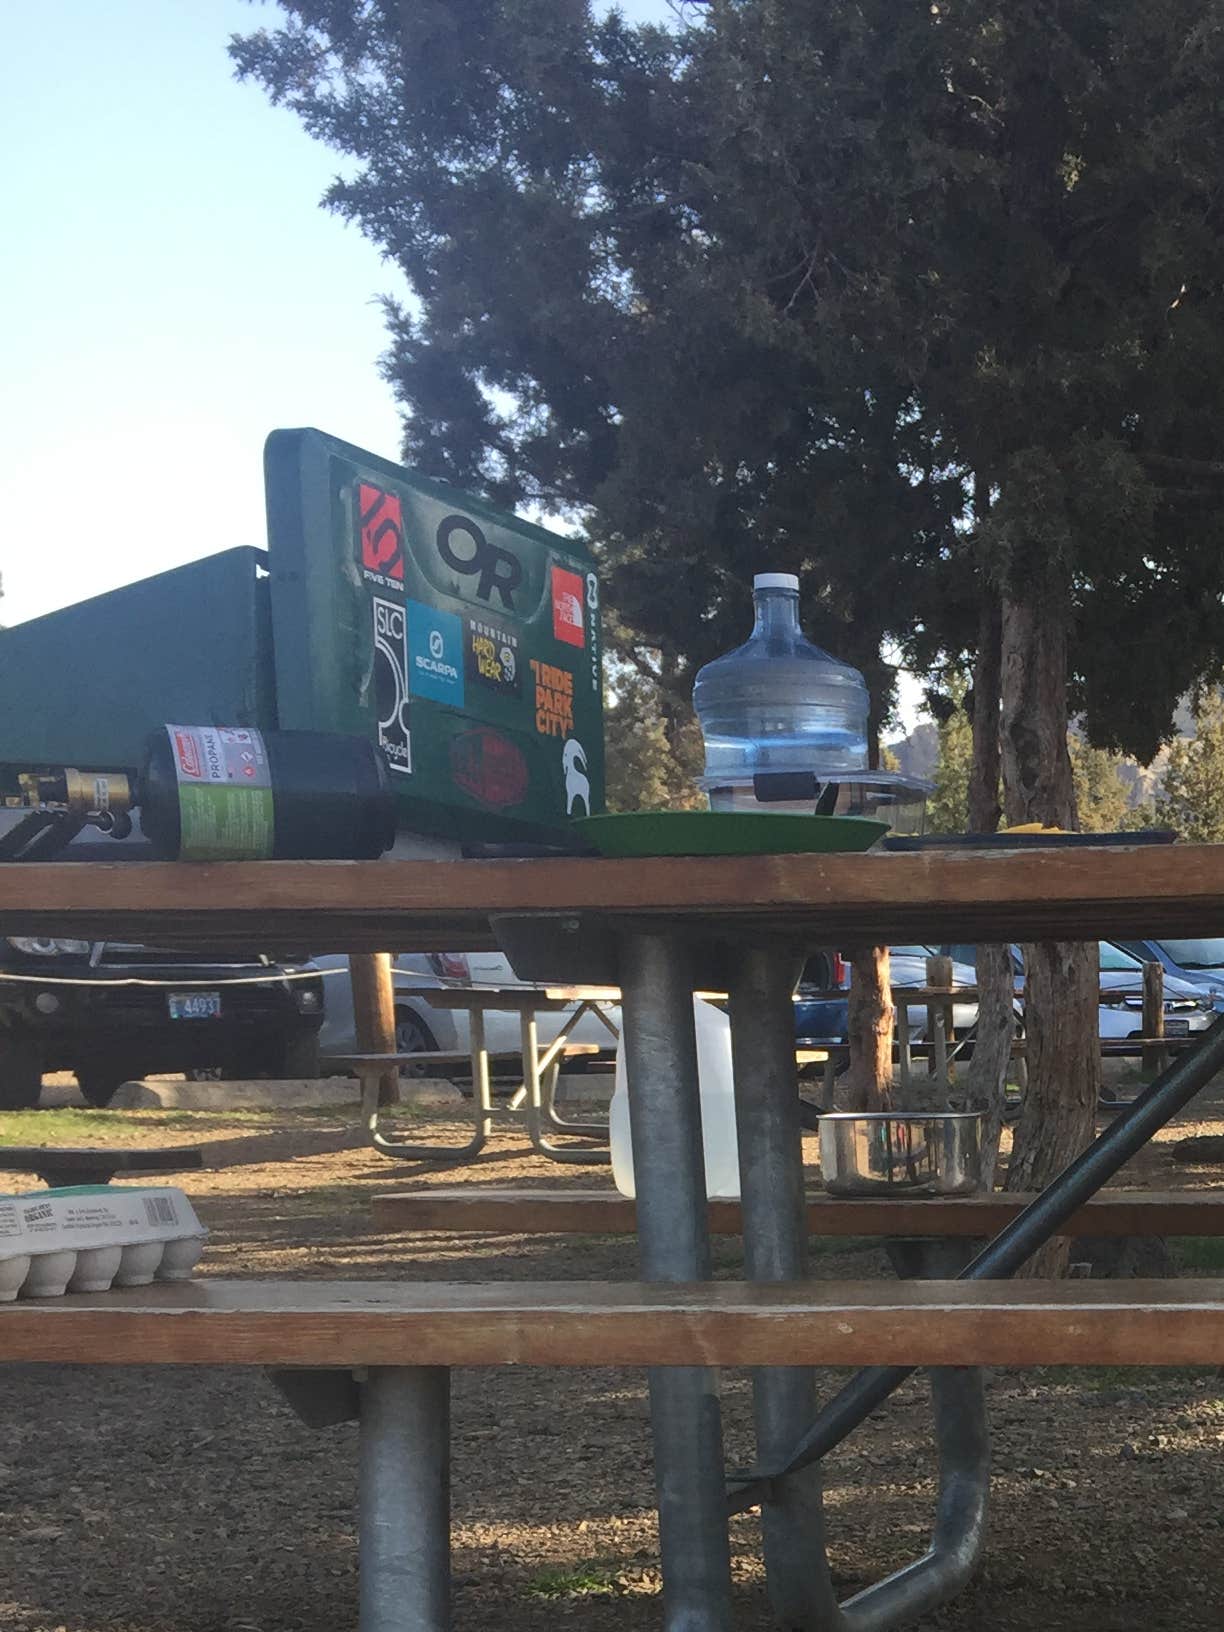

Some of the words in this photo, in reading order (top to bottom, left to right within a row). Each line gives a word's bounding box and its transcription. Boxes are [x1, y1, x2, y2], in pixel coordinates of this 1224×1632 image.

[437, 514, 521, 610] OR
[363, 569, 384, 585] FIVE
[385, 576, 404, 592] TEN
[377, 606, 403, 640] SLC
[470, 620, 518, 648] MOUNTAIN
[415, 655, 458, 679] SCARPA
[204, 733, 221, 779] PROPANE
